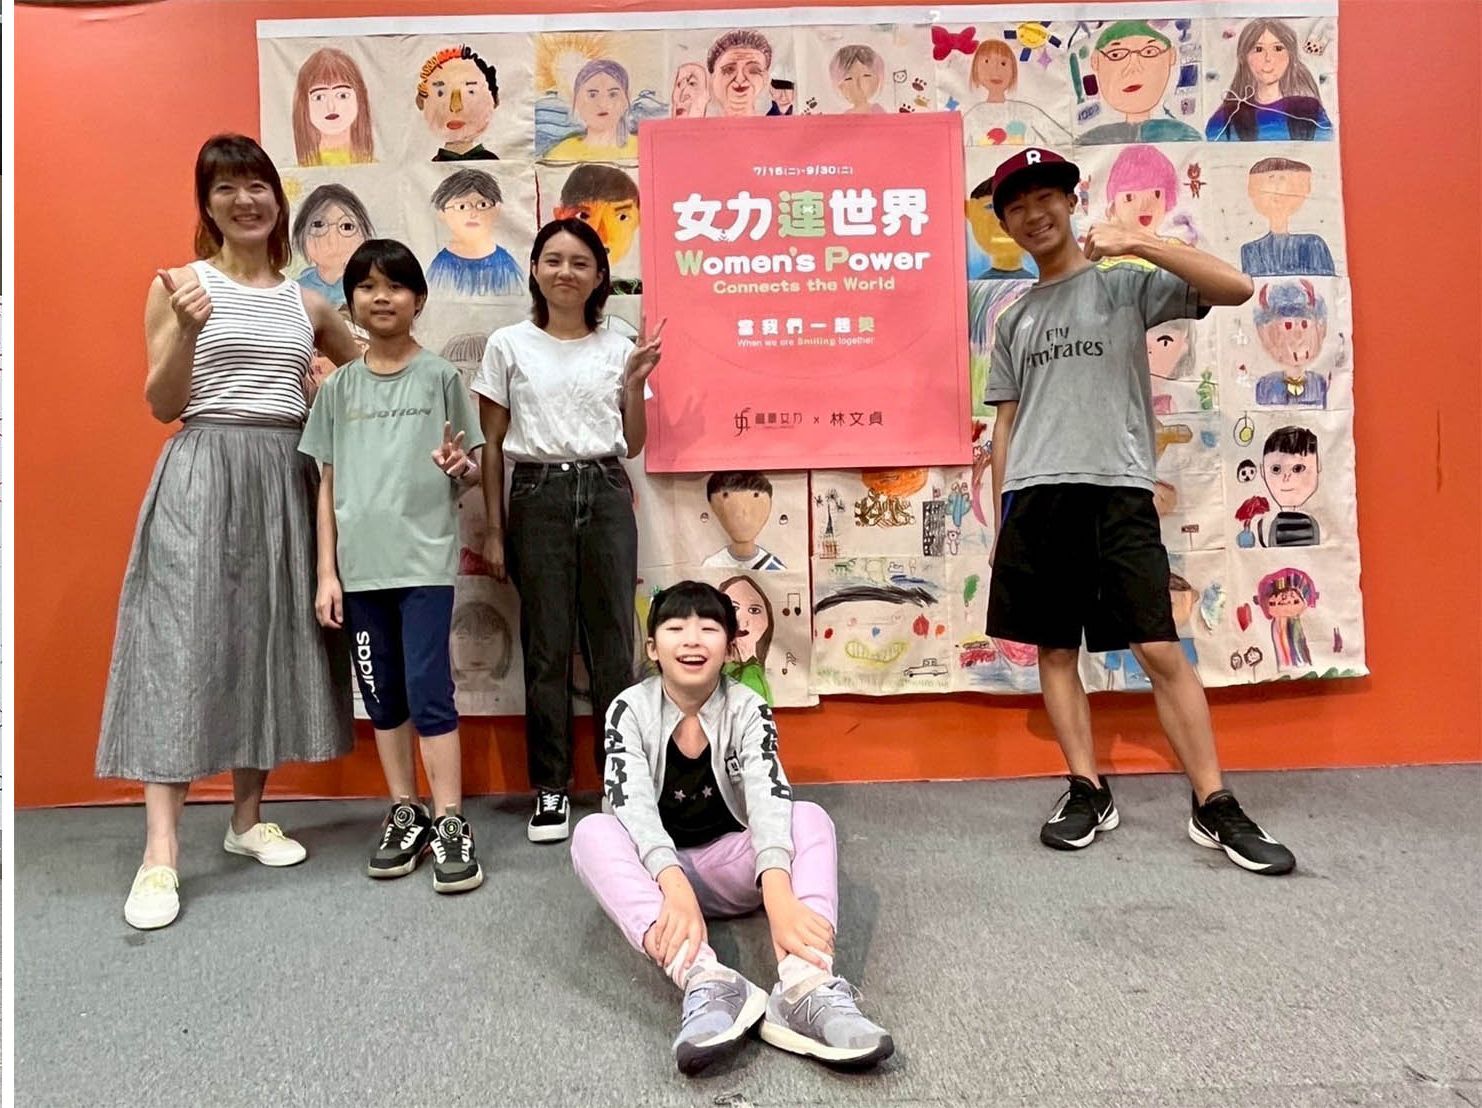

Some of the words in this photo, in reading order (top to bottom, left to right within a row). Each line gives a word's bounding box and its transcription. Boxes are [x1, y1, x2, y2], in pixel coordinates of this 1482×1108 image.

[672, 188, 930, 243] 女力連世界
[675, 246, 816, 277] Women's
[824, 246, 931, 273] Power
[713, 279, 801, 294] Connects
[806, 278, 838, 292] the
[843, 277, 896, 292] World
[1026, 340, 1104, 367] mirates
[356, 631, 380, 704] idas
